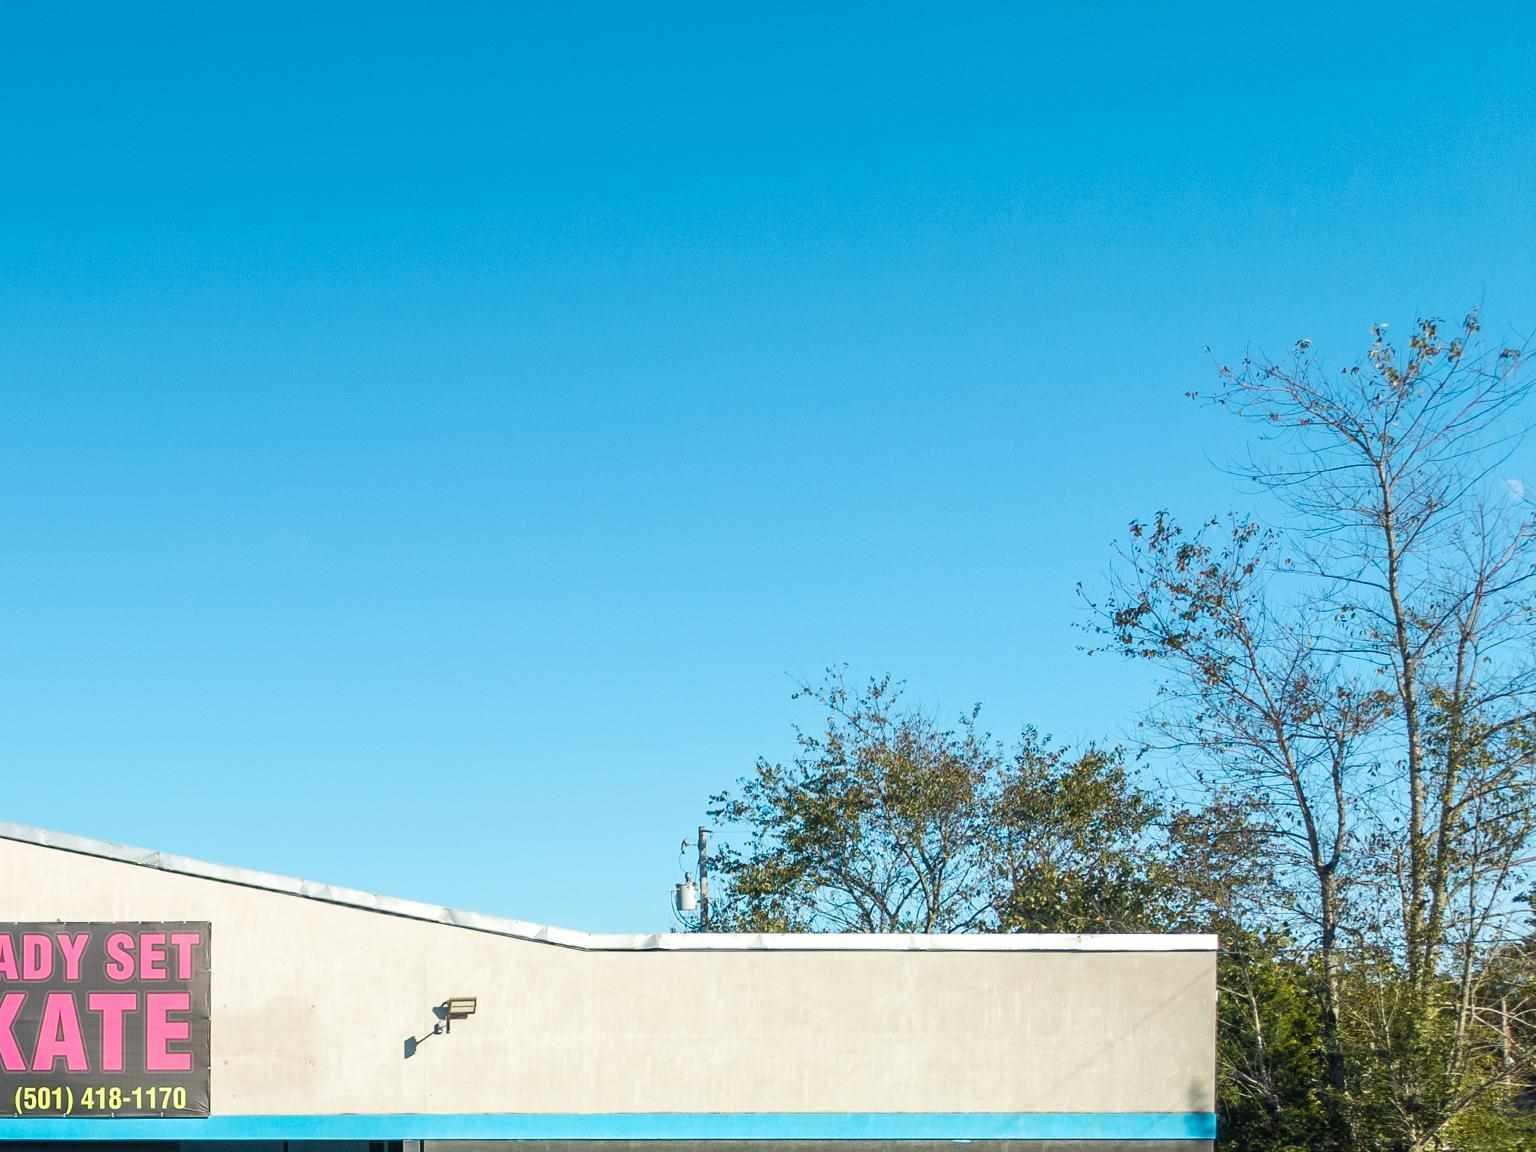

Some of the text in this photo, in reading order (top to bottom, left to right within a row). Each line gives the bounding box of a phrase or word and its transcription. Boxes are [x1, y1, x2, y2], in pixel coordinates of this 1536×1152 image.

[105, 932, 202, 982] SET
[14, 1086, 75, 1114] (501)
[79, 1086, 187, 1110] 418-1170
